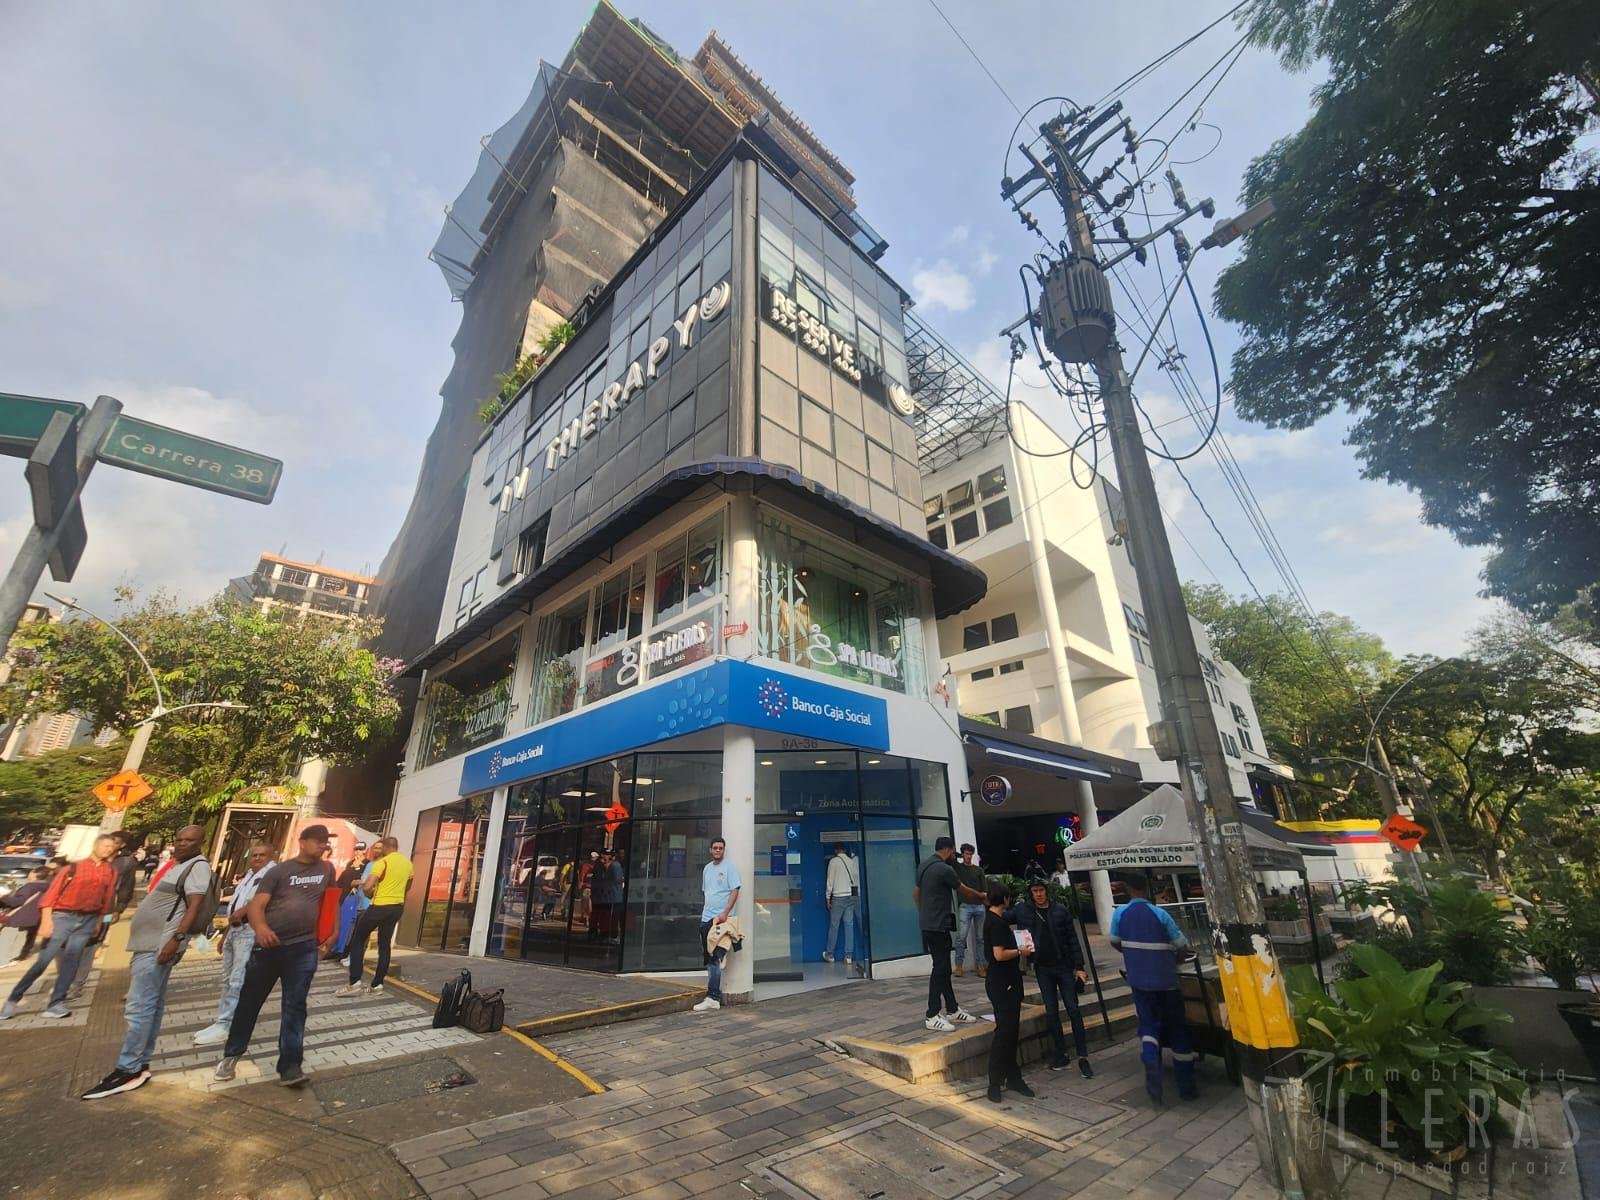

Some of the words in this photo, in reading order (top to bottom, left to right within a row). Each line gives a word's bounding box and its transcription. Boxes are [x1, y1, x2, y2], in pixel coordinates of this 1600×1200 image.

[772, 289, 854, 364] RESERVE
[546, 304, 698, 472] THERAPY
[120, 433, 222, 473] Carrera
[230, 464, 264, 484] 38
[791, 696, 823, 715] Banco
[823, 704, 844, 722] Caja
[845, 709, 872, 726] Social
[501, 756, 516, 768] Banco
[516, 751, 528, 764] Caja
[527, 744, 544, 759] Social
[818, 799, 840, 808] Zona
[1097, 854, 1137, 867] ESTACIÓN
[1139, 855, 1182, 864] POBLADO
[289, 874, 324, 885] Tommy
